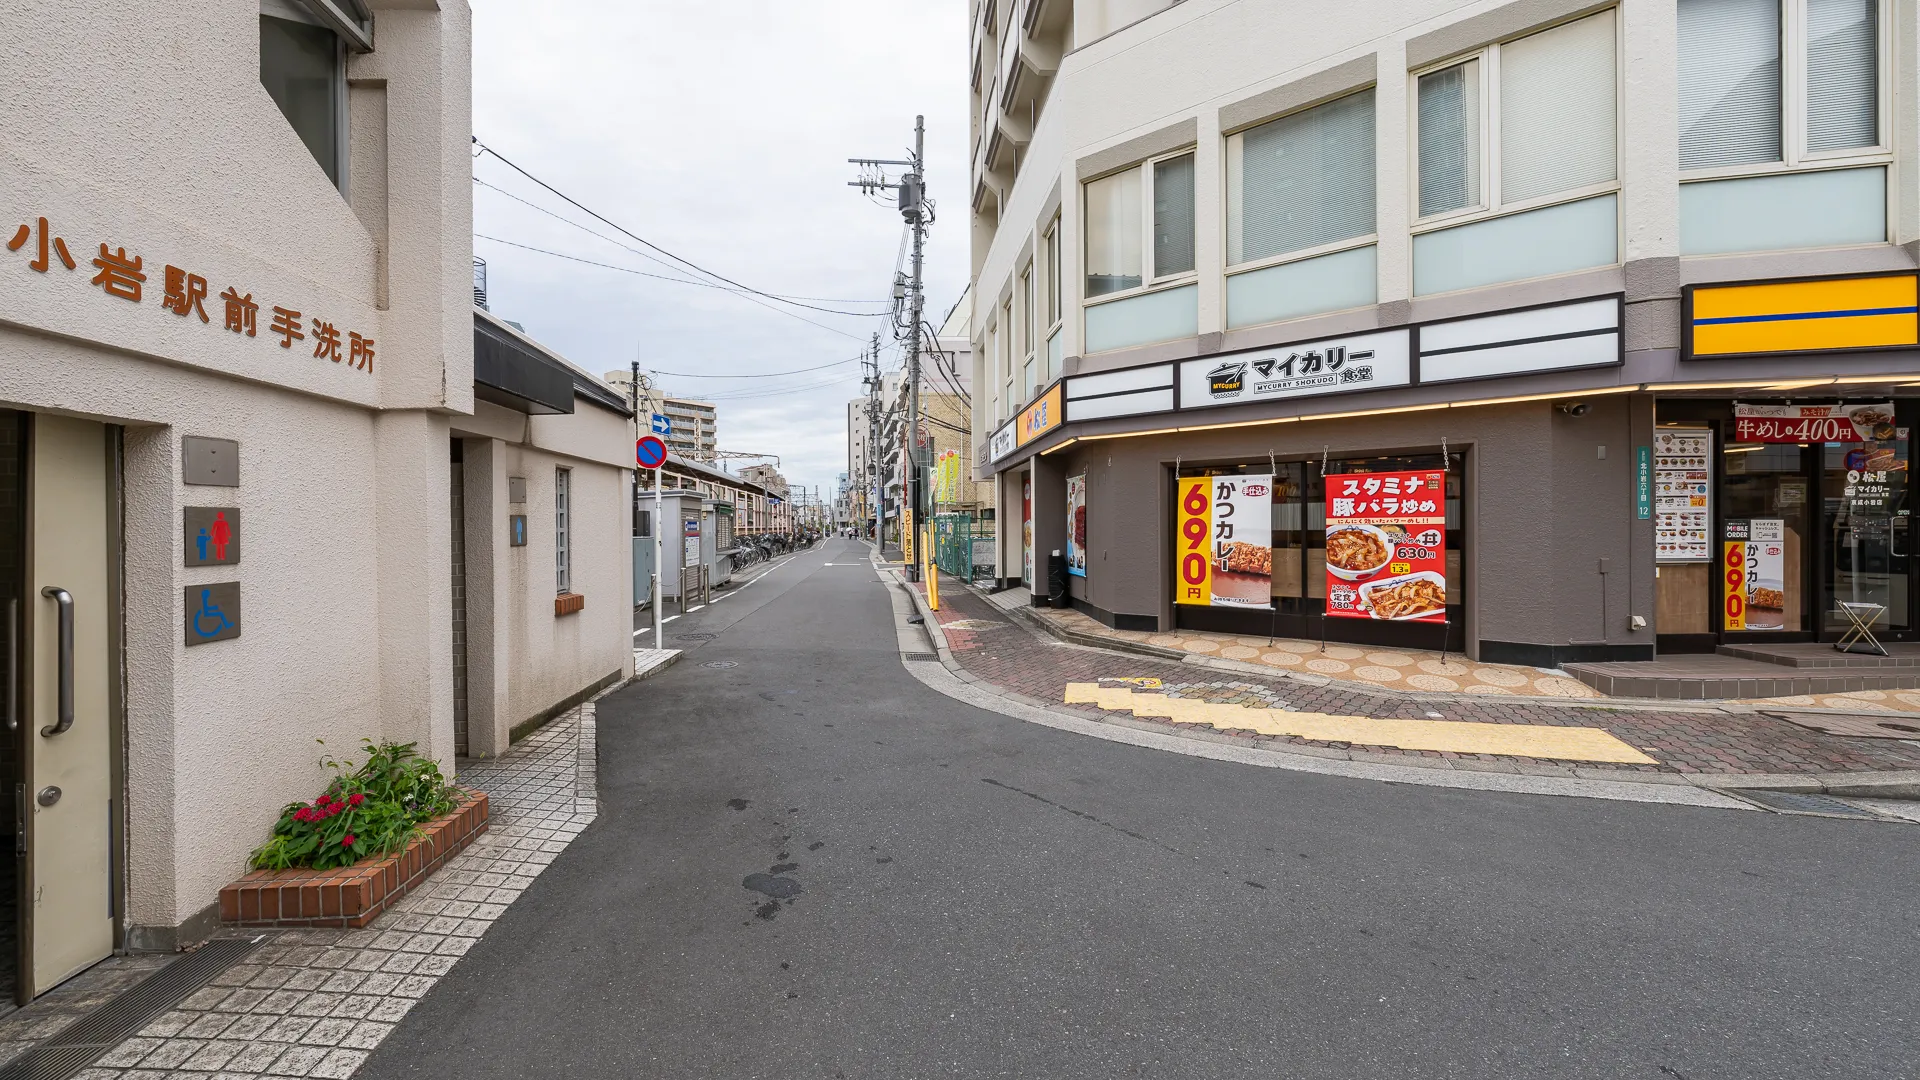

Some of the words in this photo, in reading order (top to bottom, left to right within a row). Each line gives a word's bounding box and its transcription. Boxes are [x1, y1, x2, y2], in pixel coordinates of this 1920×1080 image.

[7, 217, 375, 373] 小岩駅前手洗所
[1252, 346, 1375, 379] マイカリー
[1257, 381, 1292, 391] MYCURRY
[1295, 376, 1334, 387] SHOKUDO
[1339, 366, 1373, 384] 食堂
[1213, 381, 1240, 390] MYCURRY
[1342, 476, 1424, 496] スタミナ
[1862, 471, 1887, 482] 松屋
[1332, 498, 1436, 517] 豚バラ炒め
[1640, 507, 1648, 515] 12
[1215, 482, 1236, 571] かつカレー
[1183, 484, 1208, 598] 690円
[1397, 547, 1436, 560] 630円
[1747, 544, 1759, 603] かつカレー
[1727, 544, 1743, 627] 690円
[1334, 593, 1352, 601] 定食
